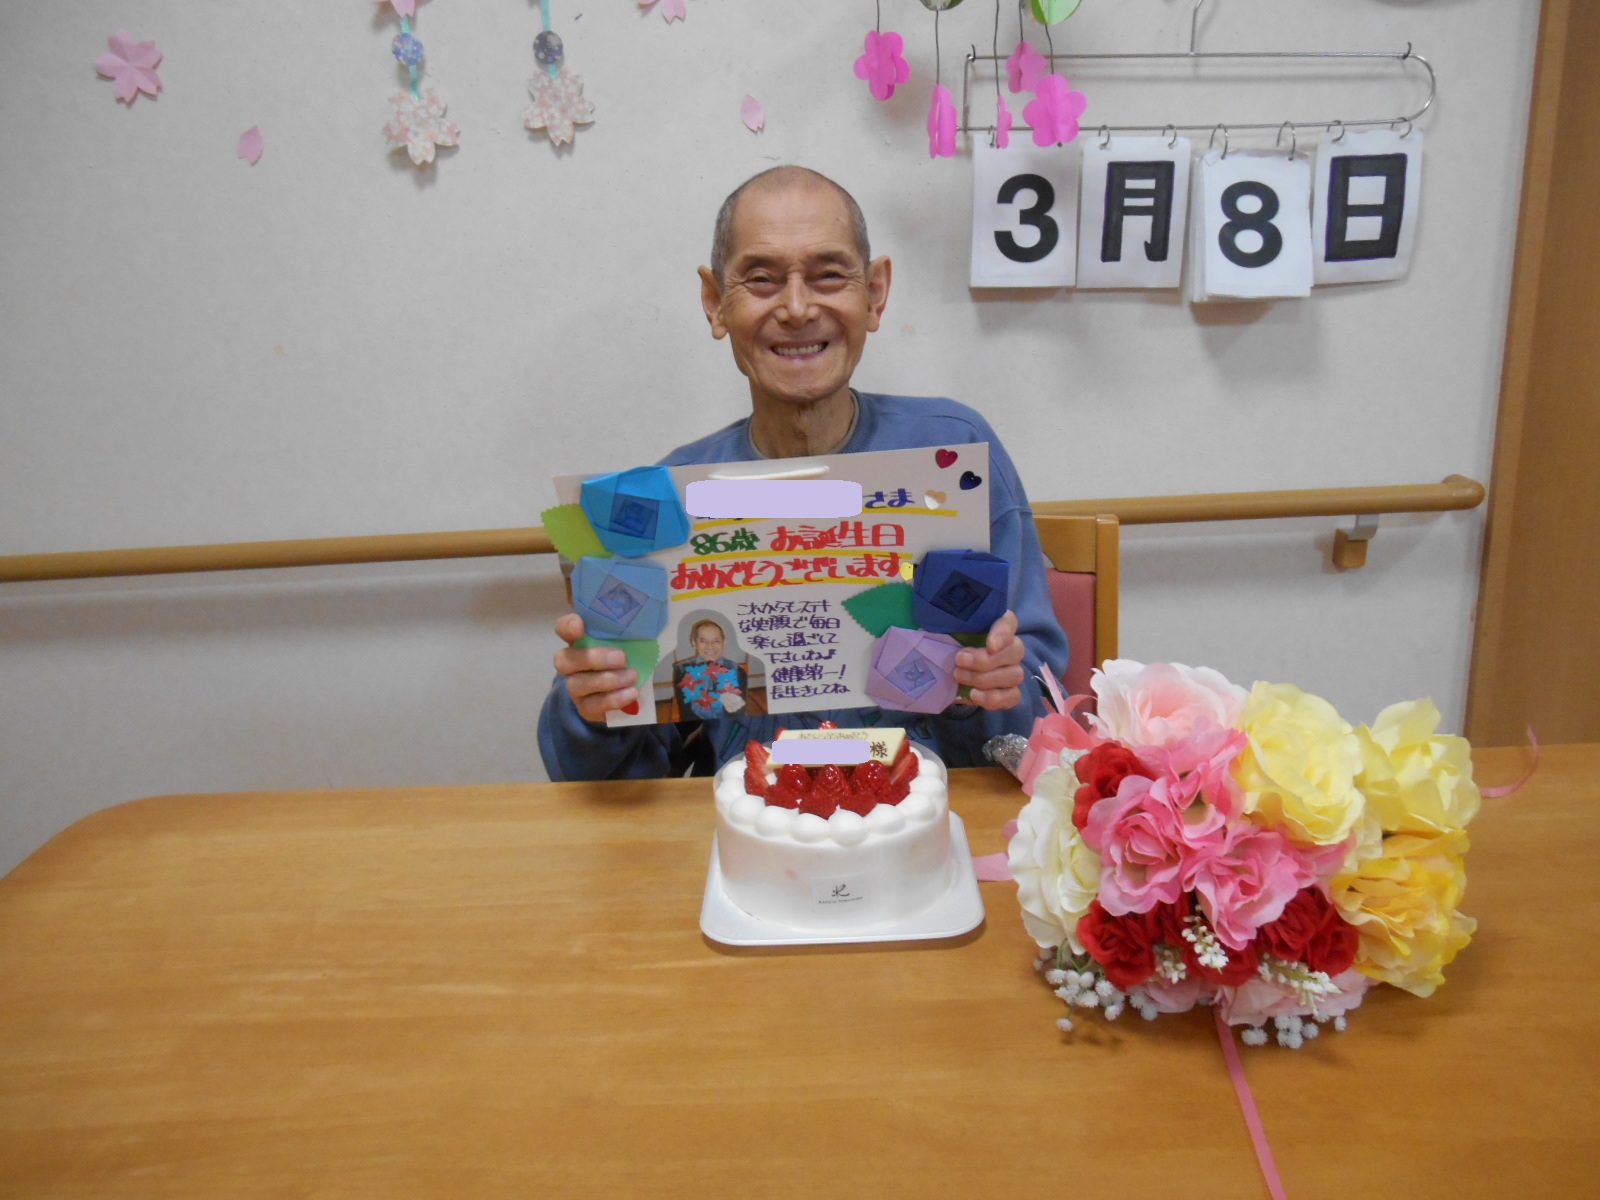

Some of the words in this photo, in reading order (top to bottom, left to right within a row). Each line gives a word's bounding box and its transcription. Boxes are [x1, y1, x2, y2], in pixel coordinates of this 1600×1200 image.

[994, 153, 1407, 268] 3月8日
[863, 488, 915, 508] さま
[690, 527, 761, 555] 86歳
[767, 521, 905, 551] お誕生日
[670, 552, 902, 589] おめでとうございます
[737, 599, 831, 615] これからもステキ
[738, 614, 840, 633] な笑顔で毎日
[770, 683, 851, 699] 長生きしてね
[870, 741, 888, 758] 様
